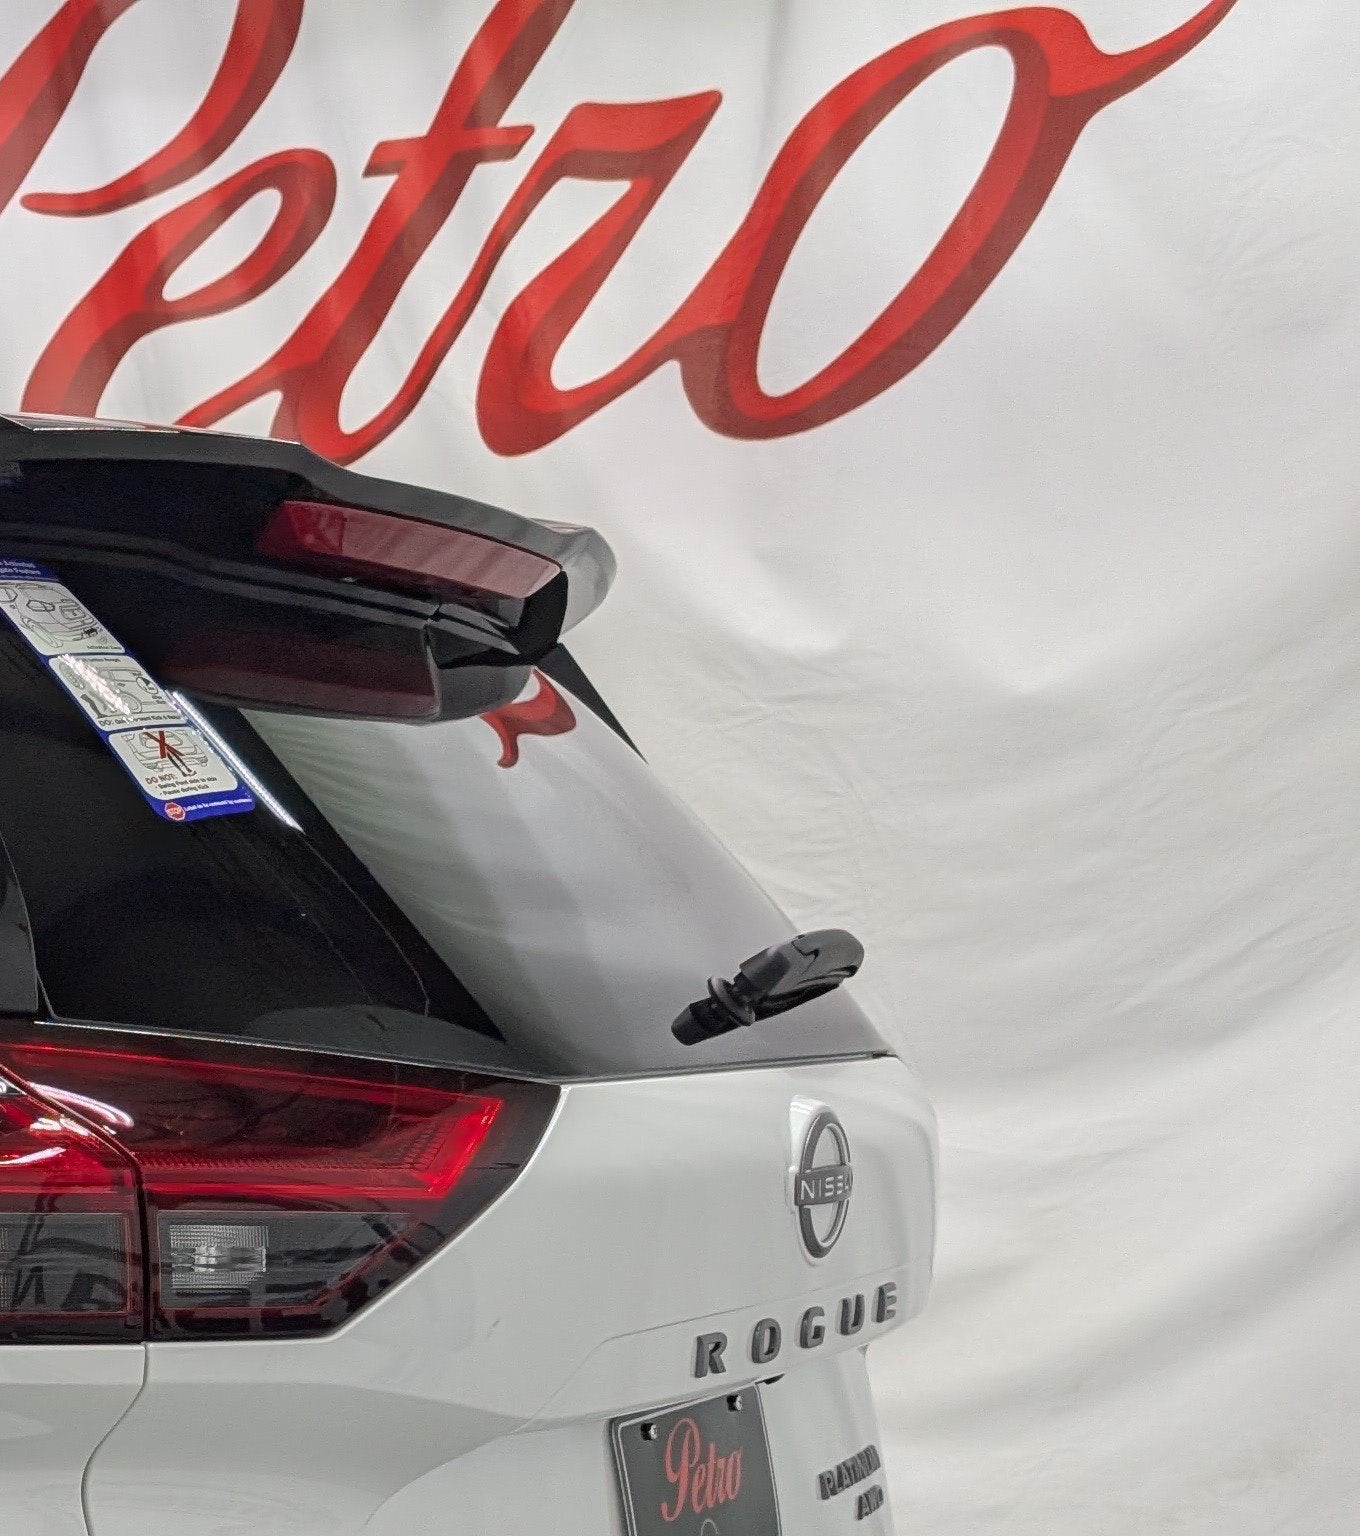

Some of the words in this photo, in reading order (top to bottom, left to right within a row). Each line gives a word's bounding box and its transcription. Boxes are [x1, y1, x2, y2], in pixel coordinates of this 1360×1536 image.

[145, 776, 158, 784] DO
[800, 1173, 850, 1200] NISS
[693, 1281, 897, 1378] ROGUE
[660, 1416, 743, 1522] Petro
